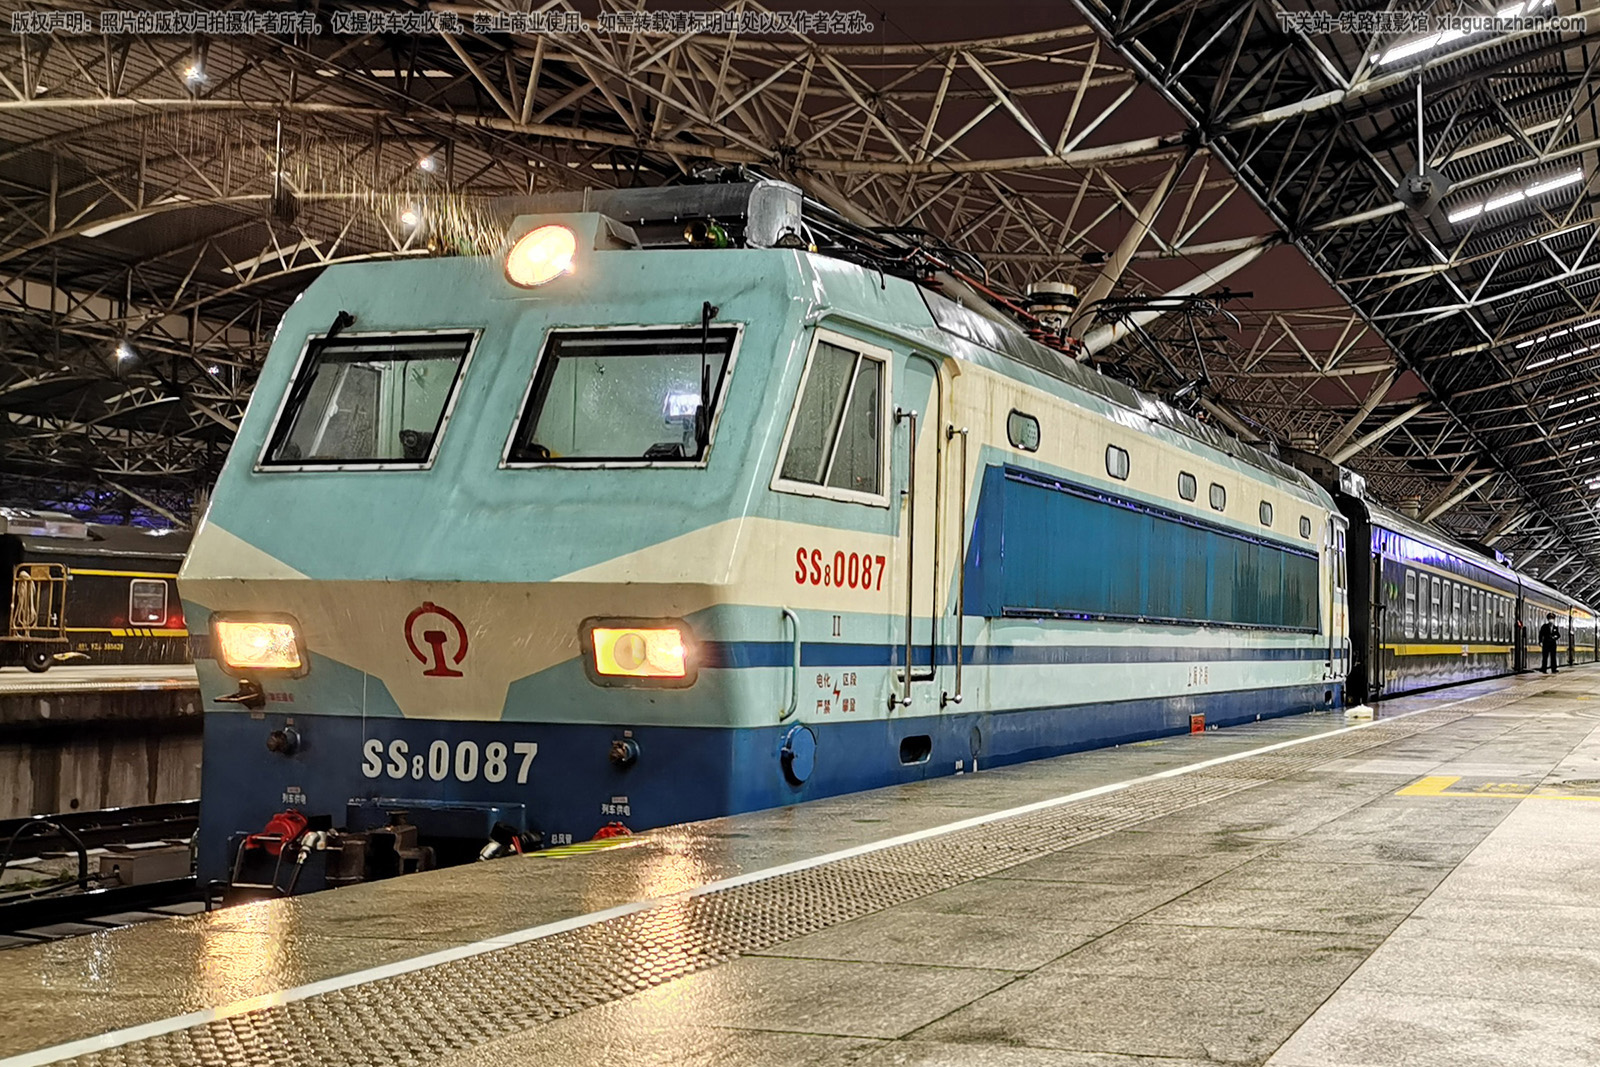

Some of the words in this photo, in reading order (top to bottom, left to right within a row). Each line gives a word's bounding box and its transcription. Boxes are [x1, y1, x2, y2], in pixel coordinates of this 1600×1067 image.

[795, 546, 886, 591] SS80087
[816, 673, 831, 688] 电化
[361, 738, 538, 784] SS80087
[601, 803, 631, 816] 列车供电
